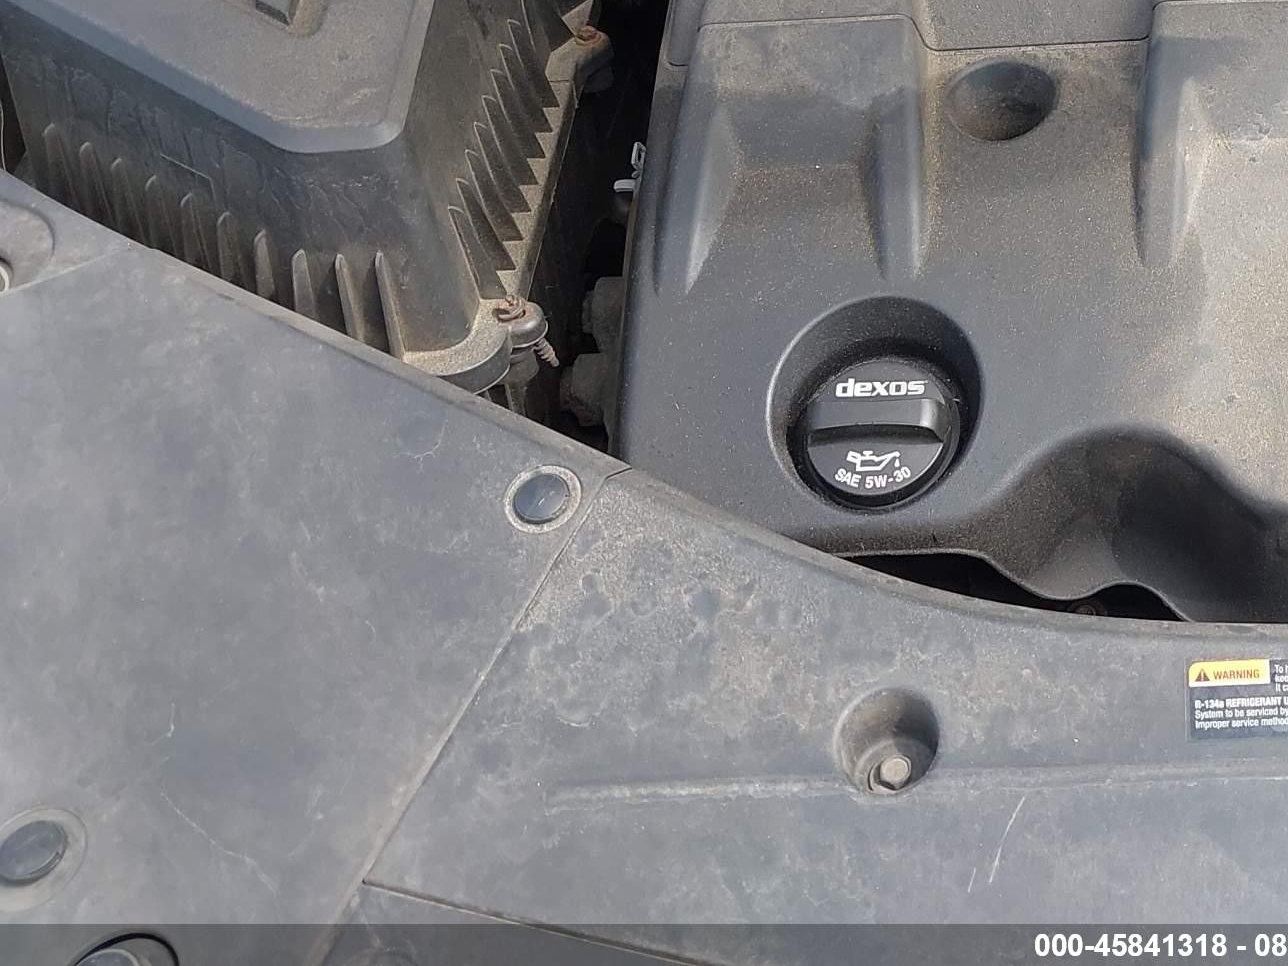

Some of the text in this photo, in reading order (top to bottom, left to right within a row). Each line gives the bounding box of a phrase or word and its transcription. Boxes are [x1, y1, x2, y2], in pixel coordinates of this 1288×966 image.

[835, 378, 925, 397] dexos
[835, 466, 911, 488] SAE 5W-30
[1213, 669, 1260, 680] WARNING
[1226, 697, 1282, 707] REFRIGERANT
